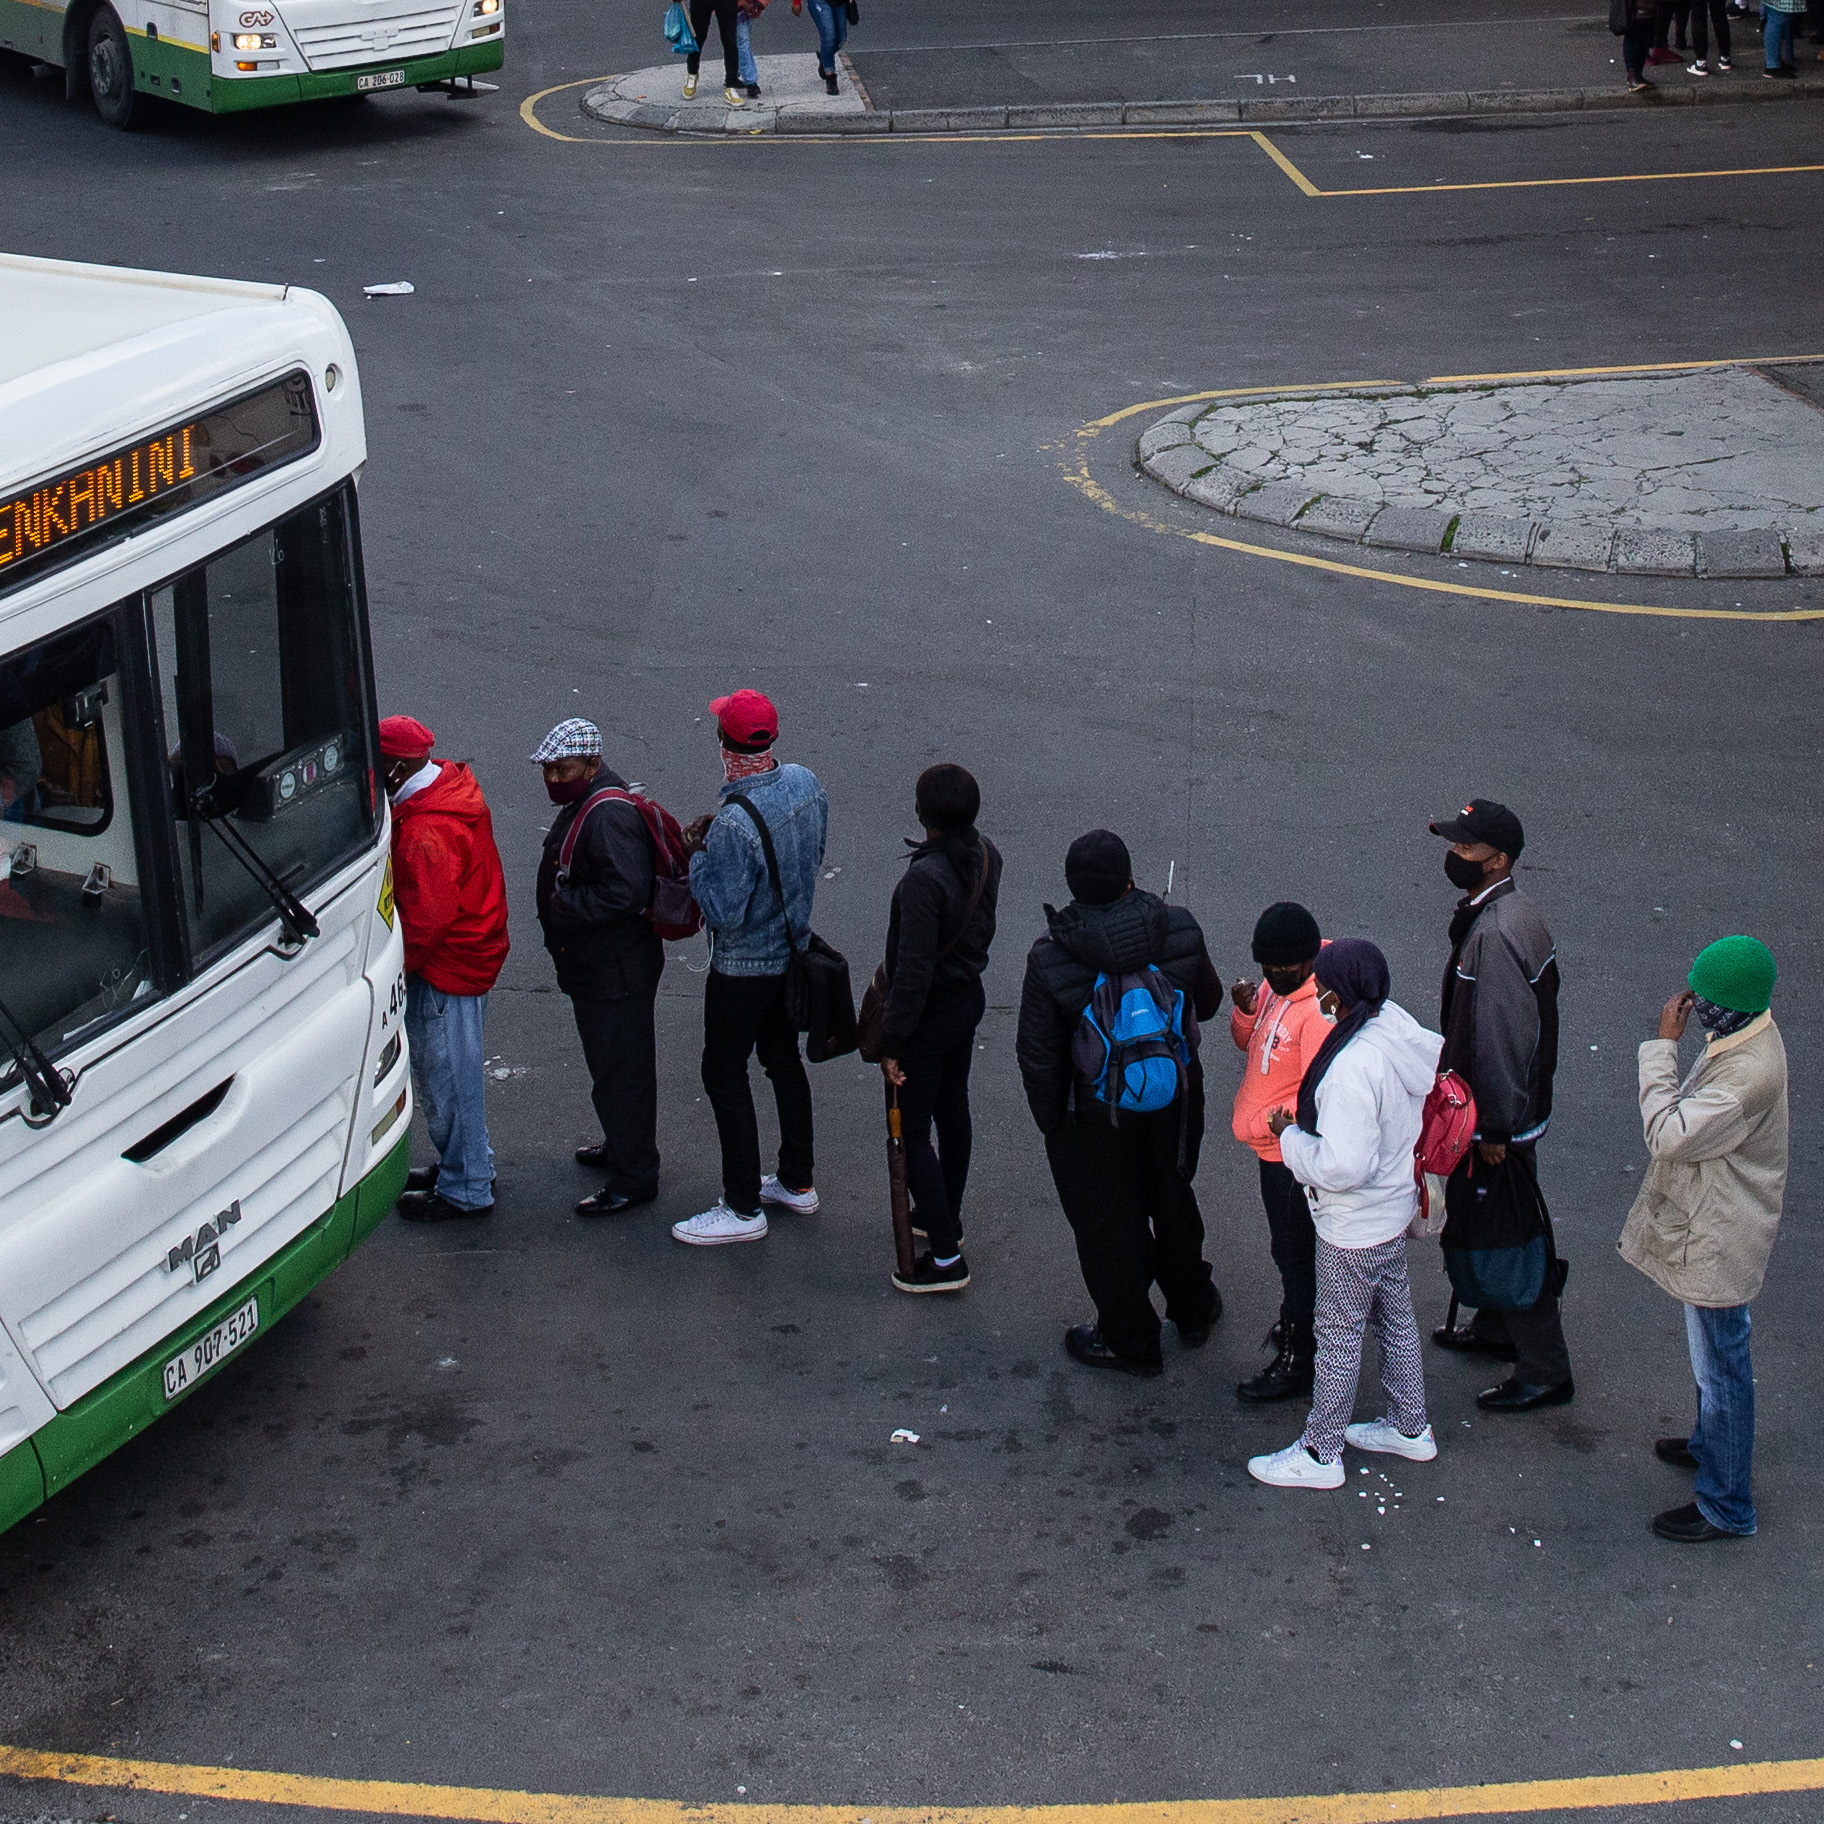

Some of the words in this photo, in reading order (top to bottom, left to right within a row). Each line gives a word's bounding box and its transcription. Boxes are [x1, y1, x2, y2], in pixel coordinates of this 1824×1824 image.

[358, 76, 370, 89] CA
[372, 71, 405, 87] 206-028
[165, 1198, 242, 1273] MAN
[164, 1362, 188, 1395] CA
